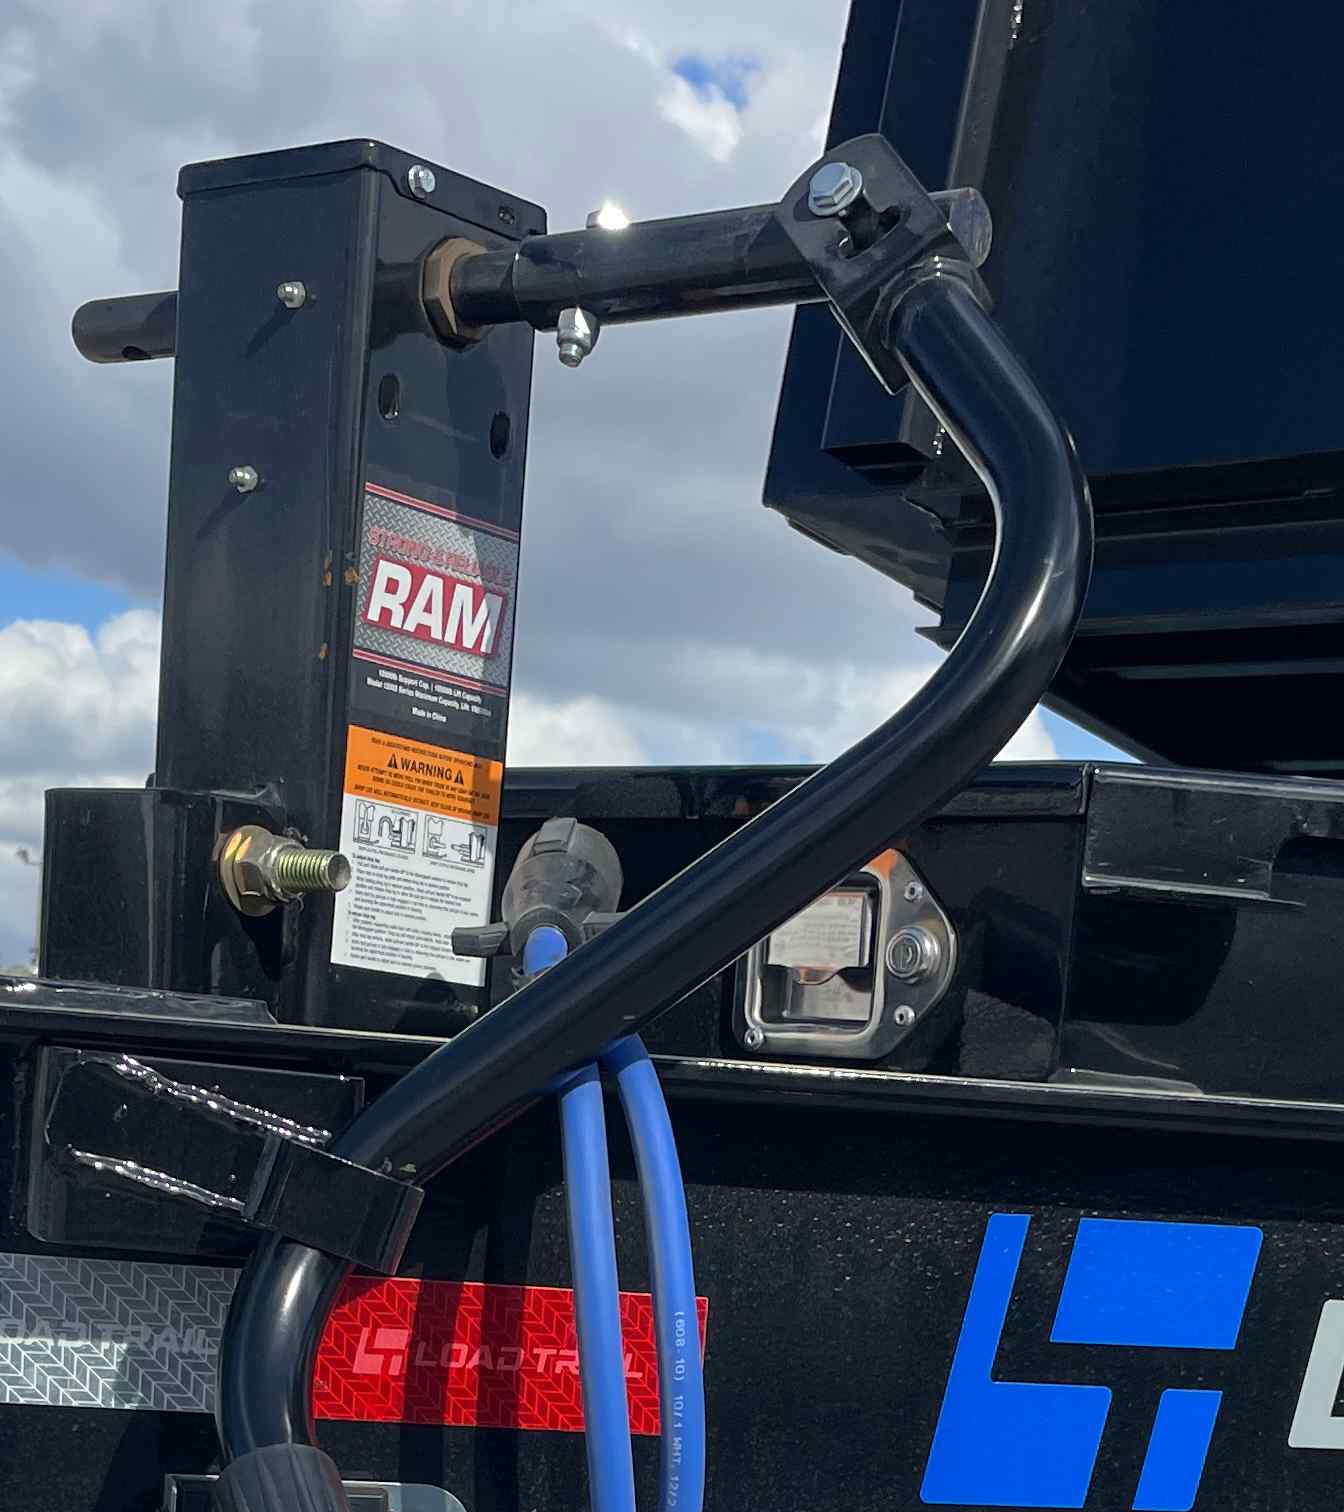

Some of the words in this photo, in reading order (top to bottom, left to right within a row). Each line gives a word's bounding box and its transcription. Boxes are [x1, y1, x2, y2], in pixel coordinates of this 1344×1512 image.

[367, 559, 504, 654] RAM
[400, 756, 453, 781] WARNING
[533, 1347, 643, 1378] TRL
